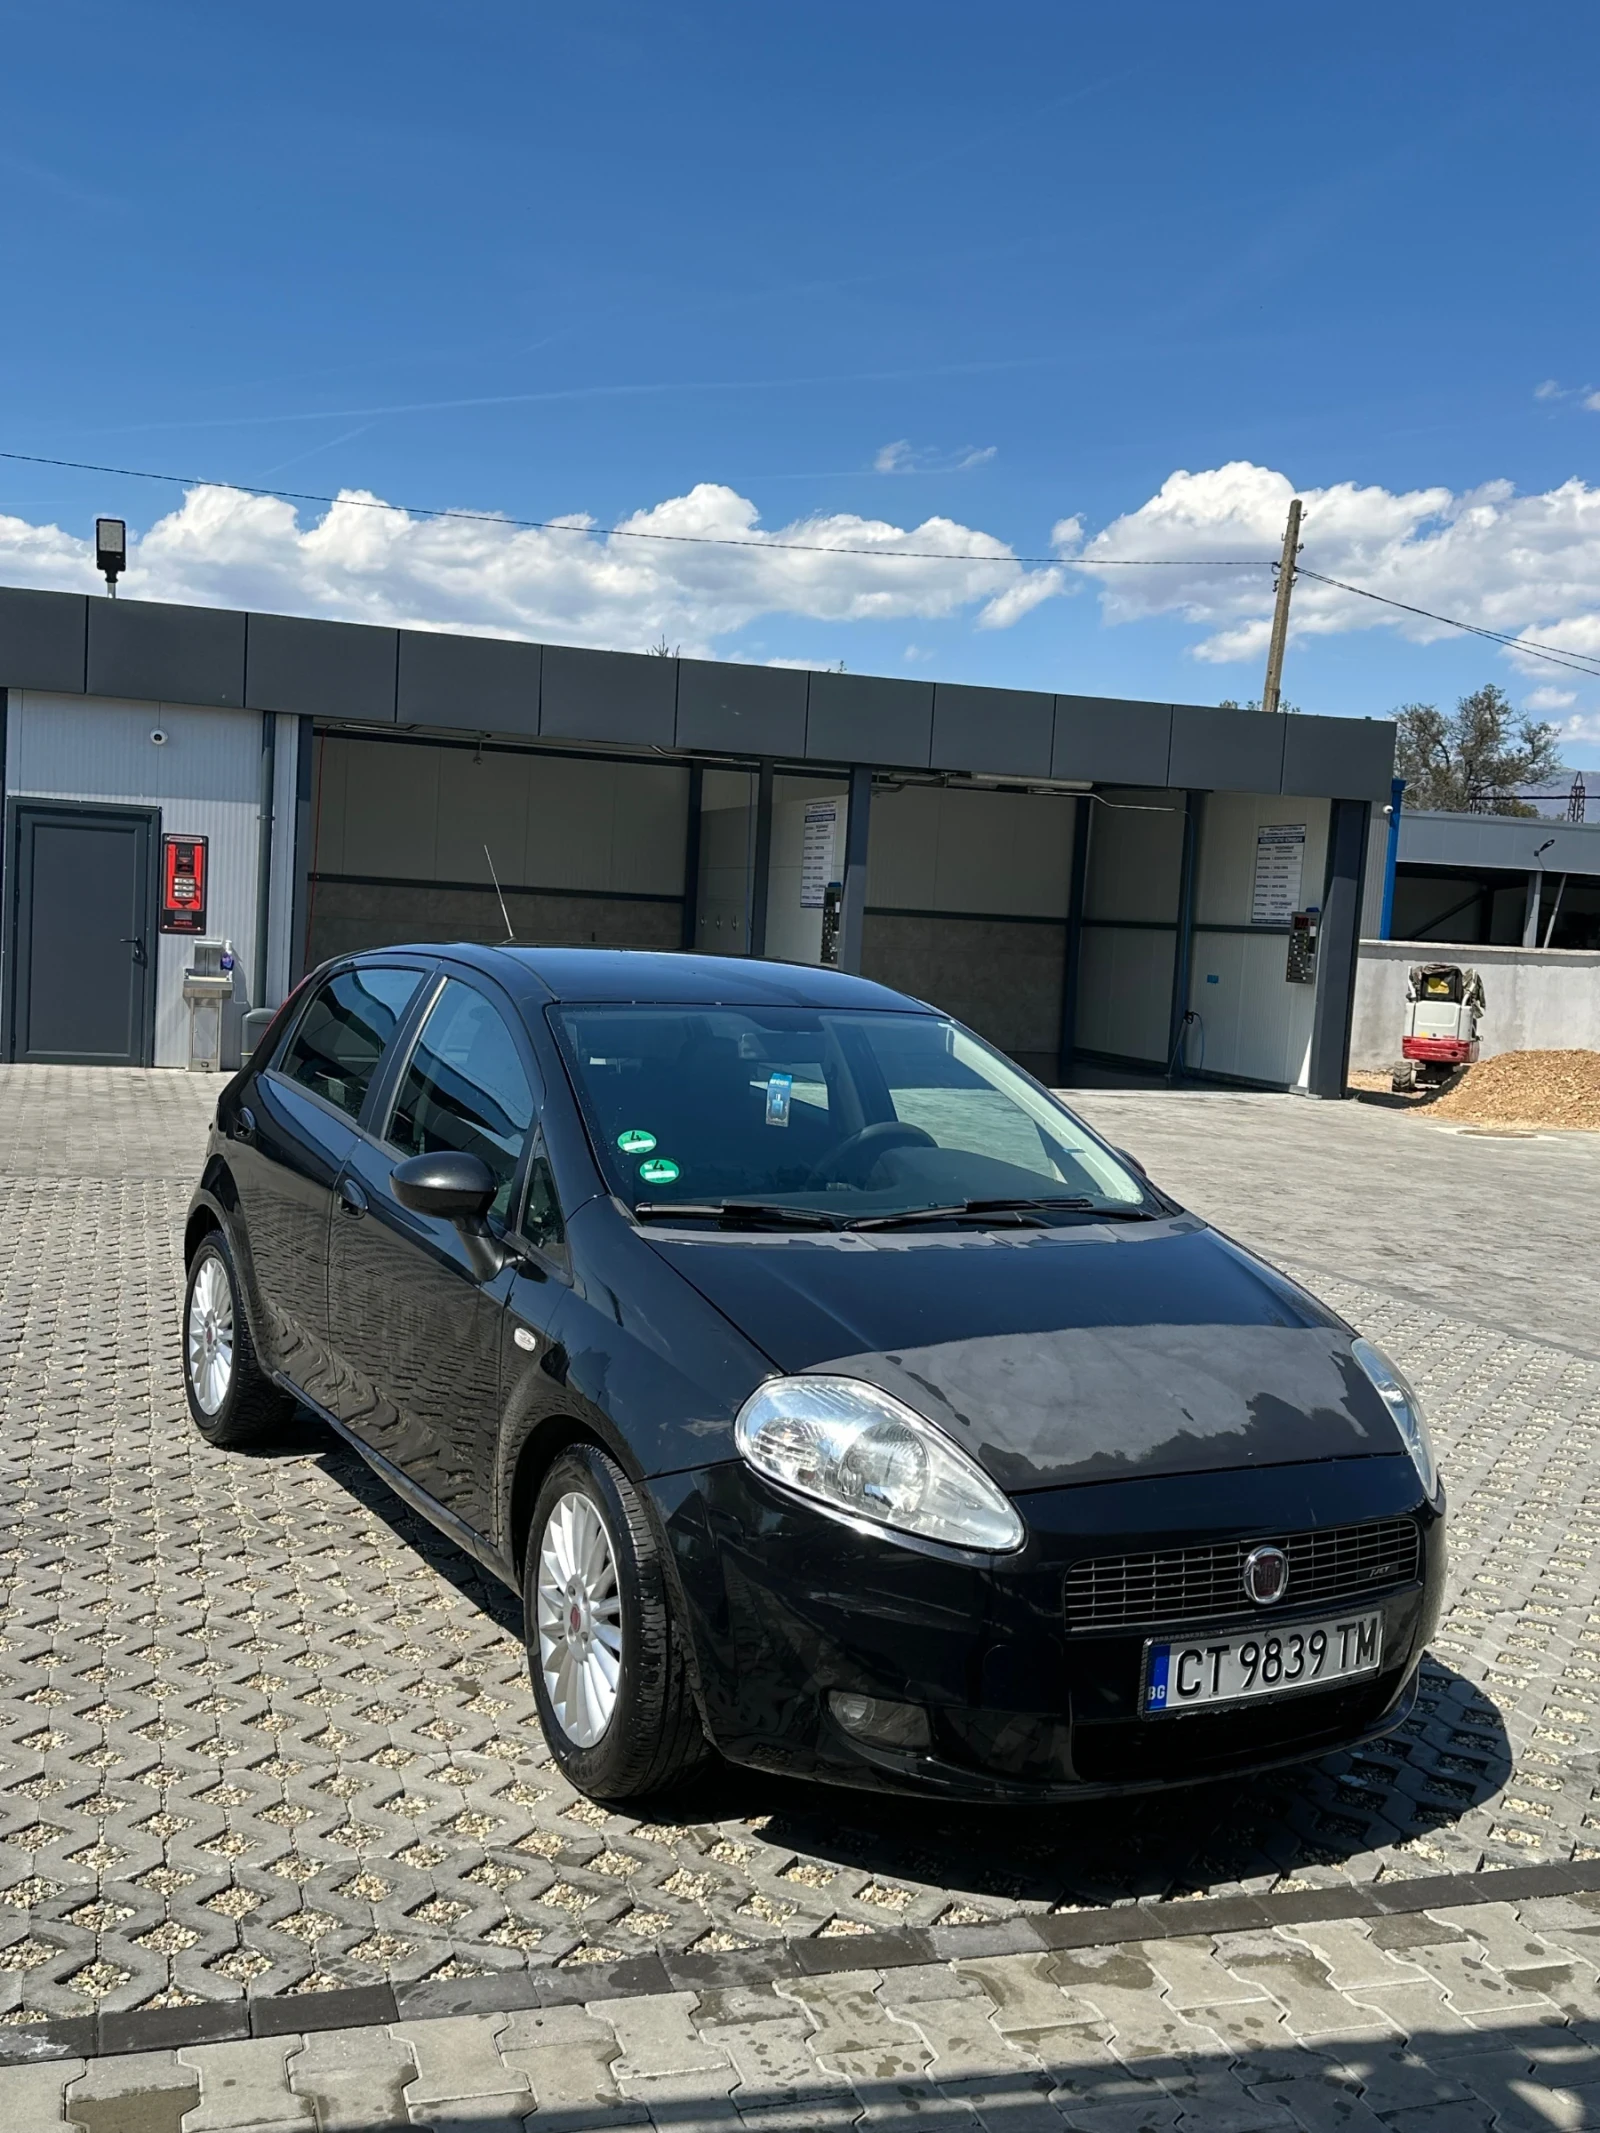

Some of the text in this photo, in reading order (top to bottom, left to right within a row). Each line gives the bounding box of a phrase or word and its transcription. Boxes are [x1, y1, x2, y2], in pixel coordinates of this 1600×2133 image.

[631, 1131, 642, 1141] 4
[653, 1160, 664, 1171] 4
[1175, 1618, 1378, 1697] CT 9839 TM
[1147, 1684, 1166, 1701] BG
